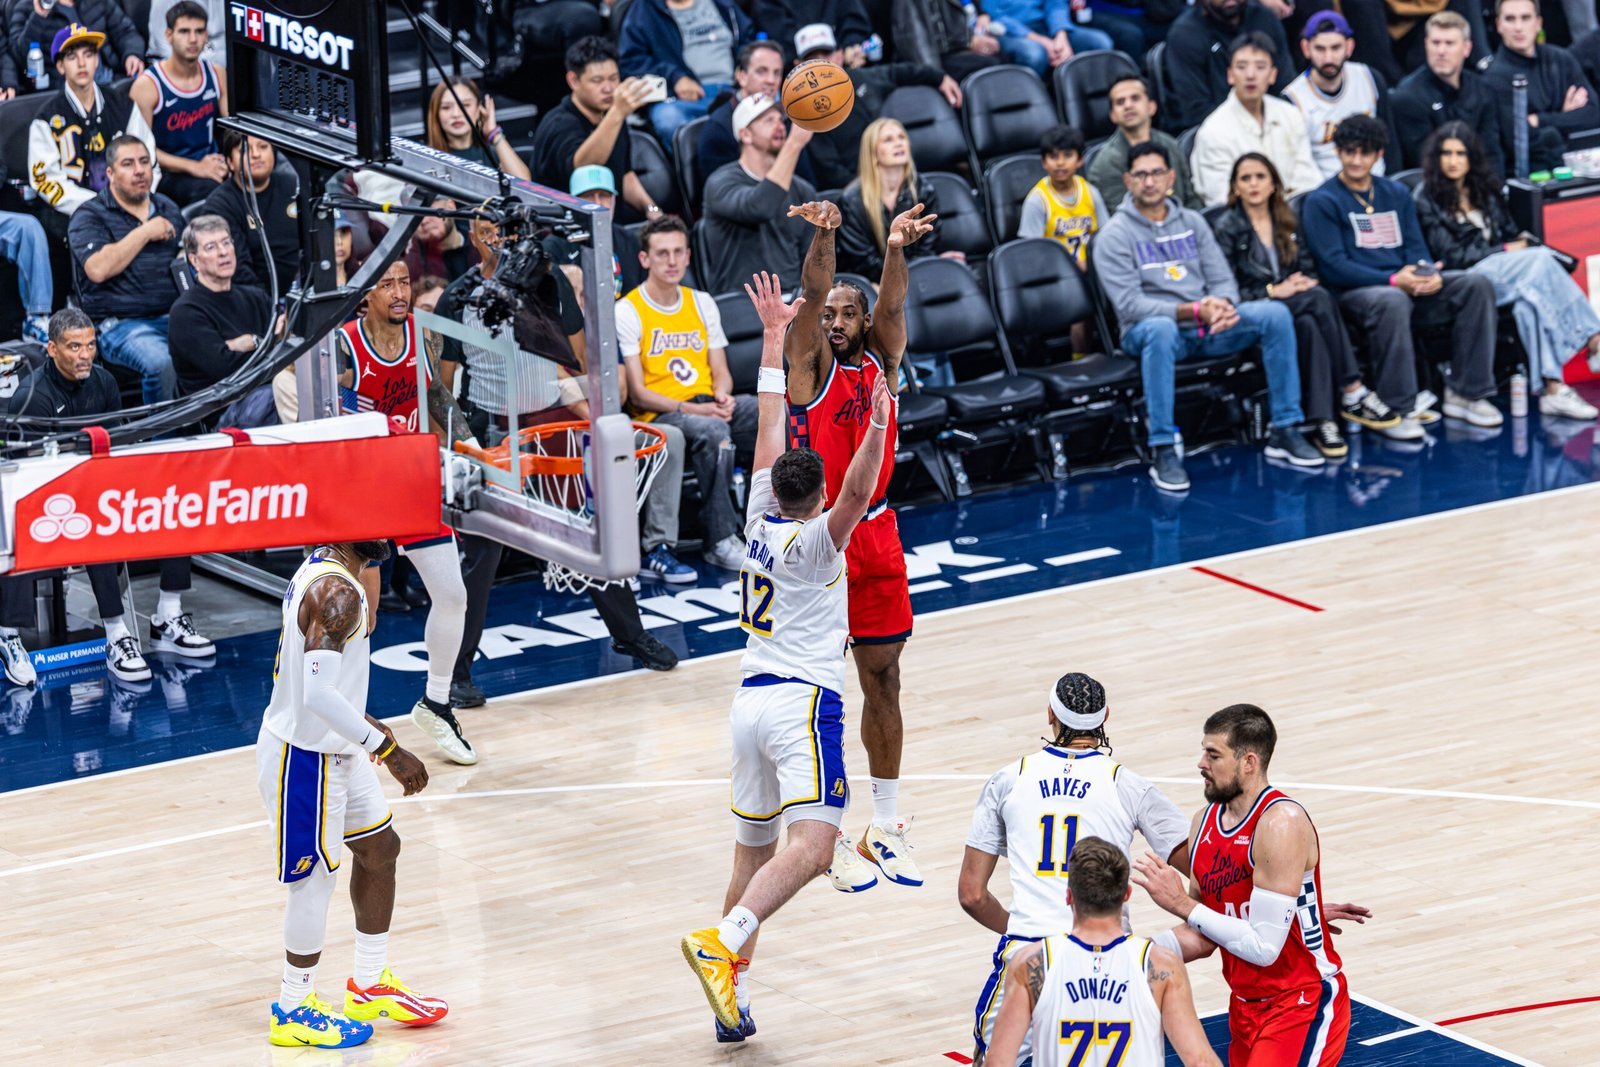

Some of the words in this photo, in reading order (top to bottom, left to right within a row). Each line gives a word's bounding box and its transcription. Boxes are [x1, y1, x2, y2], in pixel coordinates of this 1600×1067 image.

[264, 12, 354, 71] TISSOT
[739, 569, 775, 638] 12
[47, 652, 69, 664] KAISER
[70, 645, 106, 659] PERMANEN
[1038, 776, 1092, 800] HAYES
[1035, 813, 1082, 878] 11
[1210, 848, 1232, 876] Los
[1065, 973, 1130, 1005] DONČIĆ
[1059, 1019, 1132, 1067] 77
